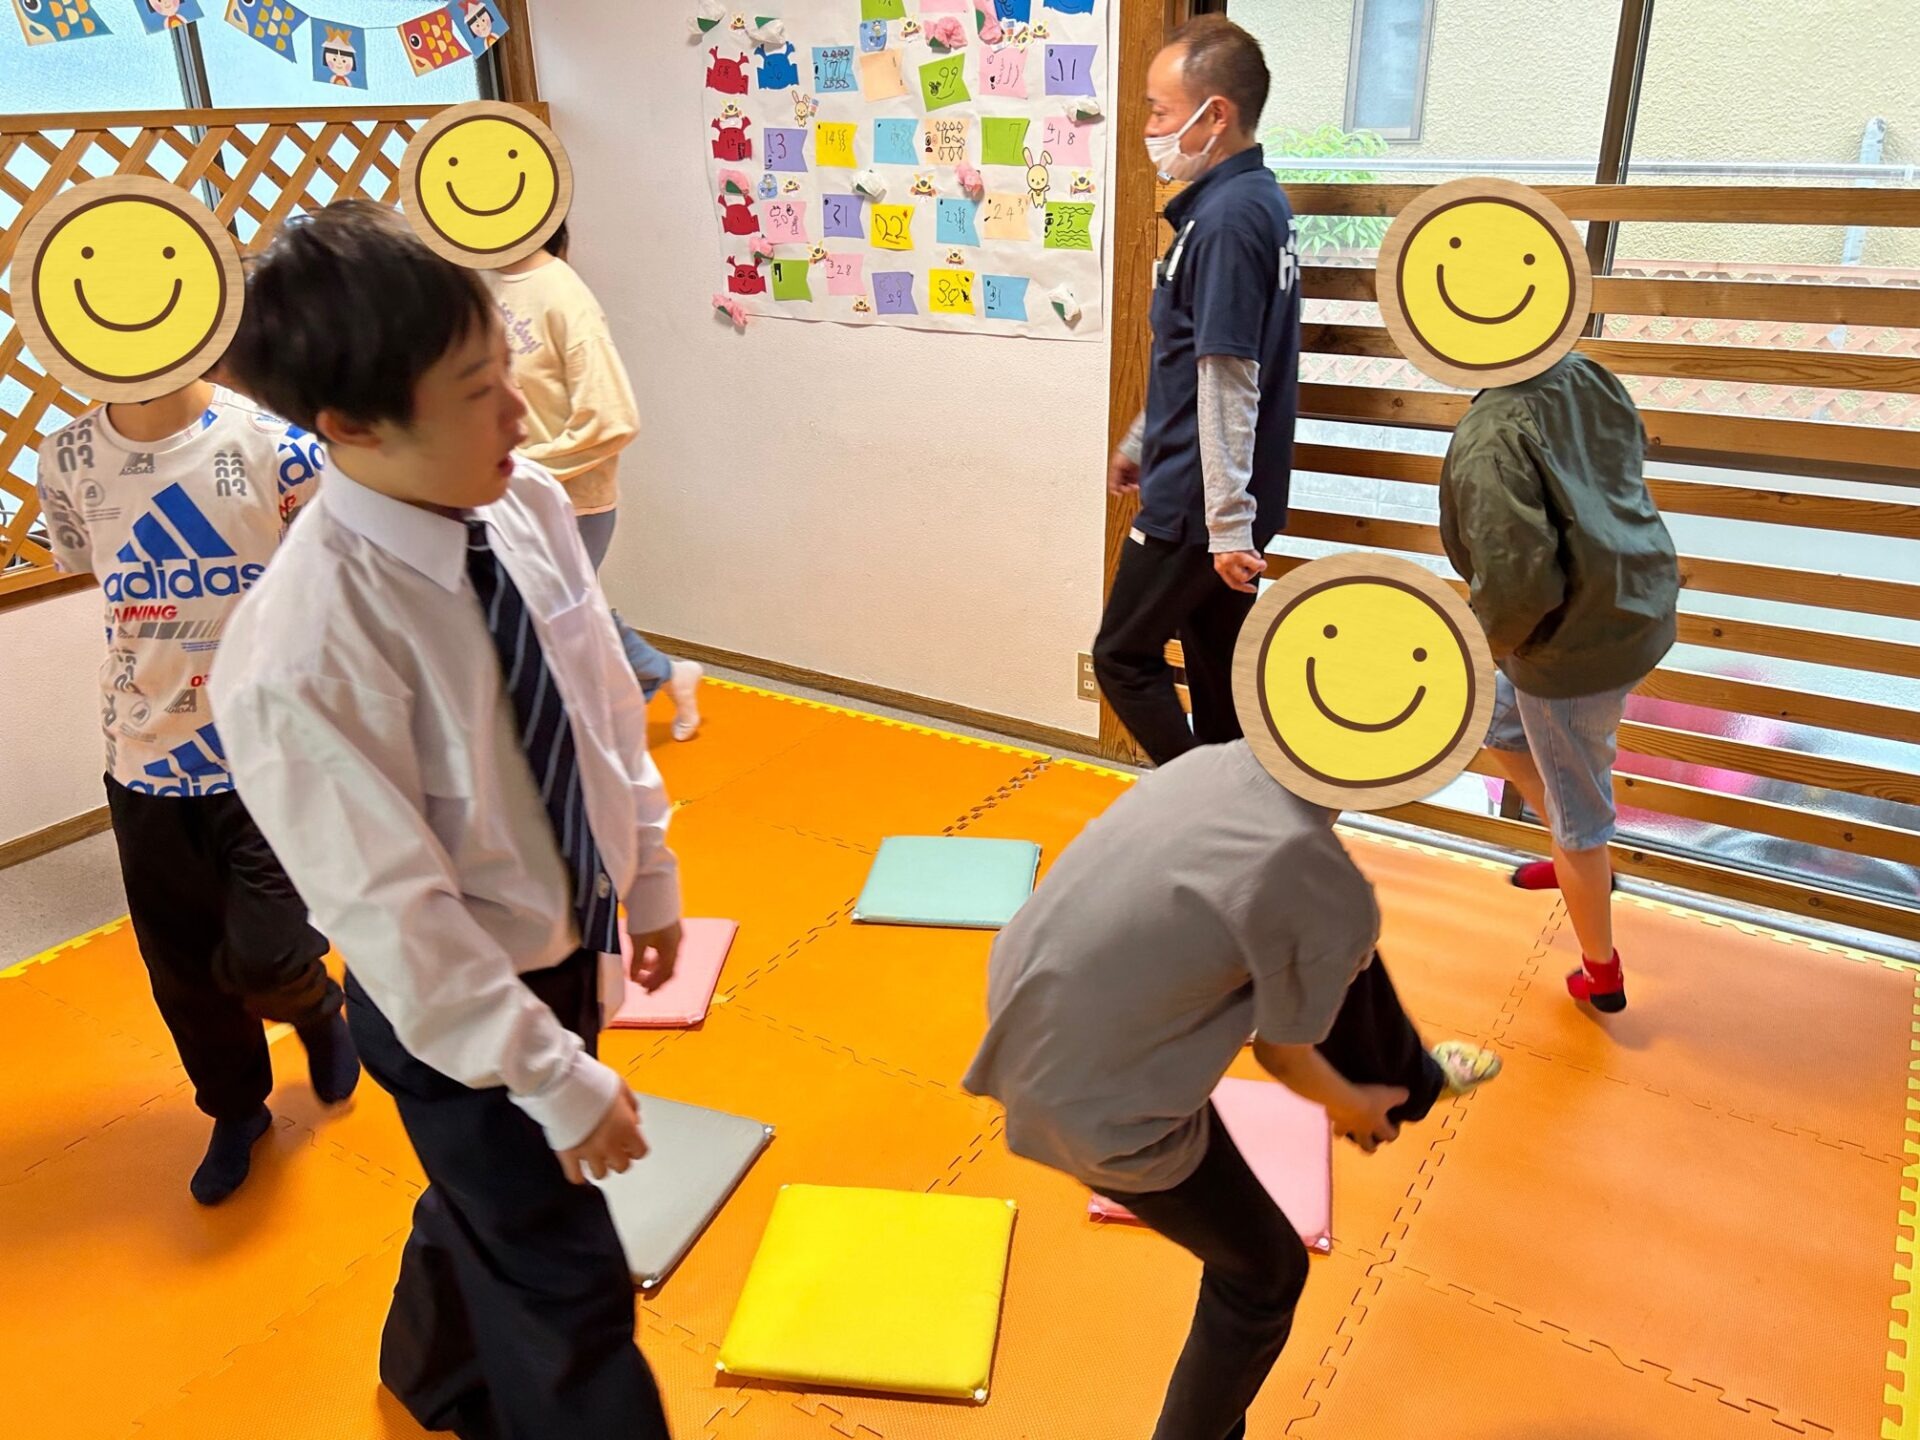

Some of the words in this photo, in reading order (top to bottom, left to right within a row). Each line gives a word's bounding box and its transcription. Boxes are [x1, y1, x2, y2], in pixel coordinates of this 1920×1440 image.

[767, 132, 787, 159] 13
[1057, 130, 1076, 146] 18
[1056, 214, 1074, 230] 25
[104, 559, 266, 602] adidas
